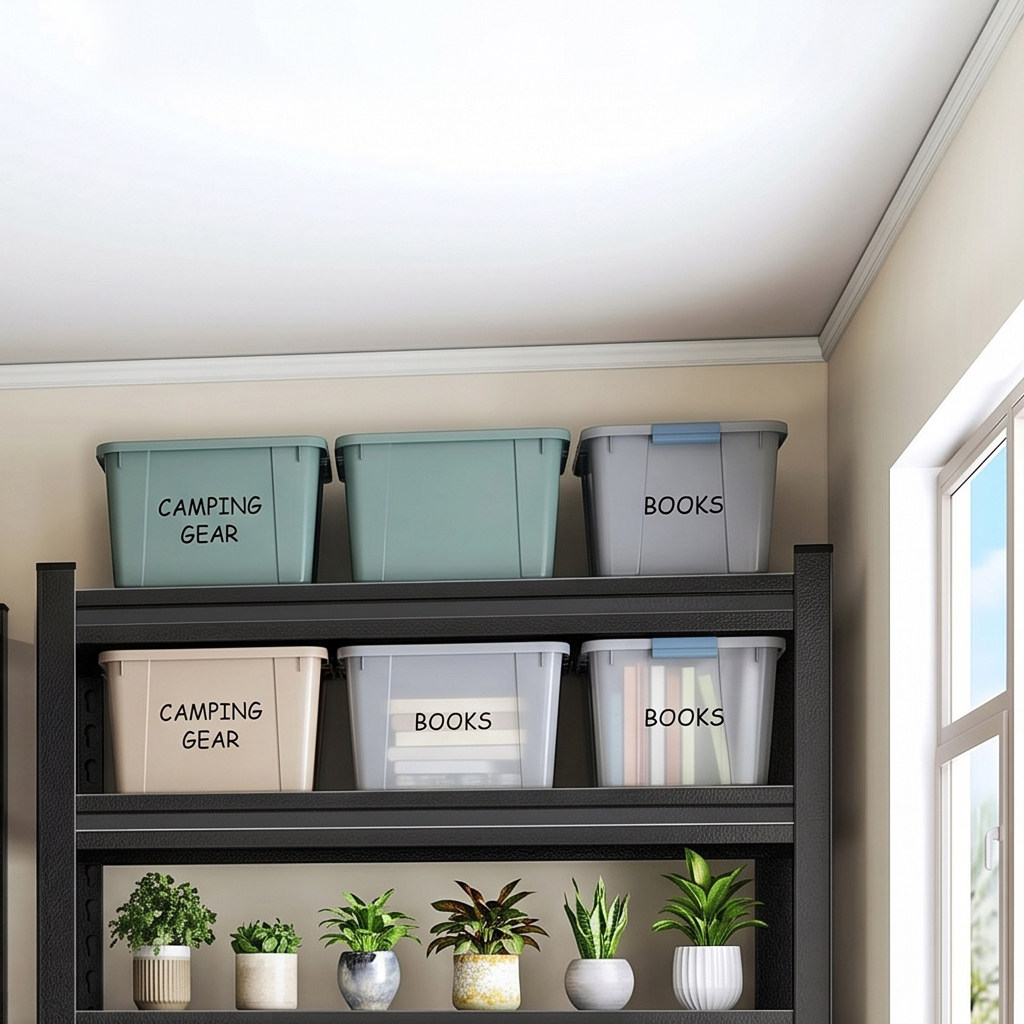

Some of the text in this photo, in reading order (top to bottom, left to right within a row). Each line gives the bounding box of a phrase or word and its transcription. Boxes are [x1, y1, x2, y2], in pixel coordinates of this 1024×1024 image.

[158, 495, 263, 517] CAMPING
[644, 494, 724, 516] BOOKS
[180, 524, 239, 545] GEAR
[159, 701, 263, 722] CAMPING
[415, 711, 492, 732] BOOKS
[644, 707, 725, 728] BOOKS
[182, 729, 240, 750] GEAR
